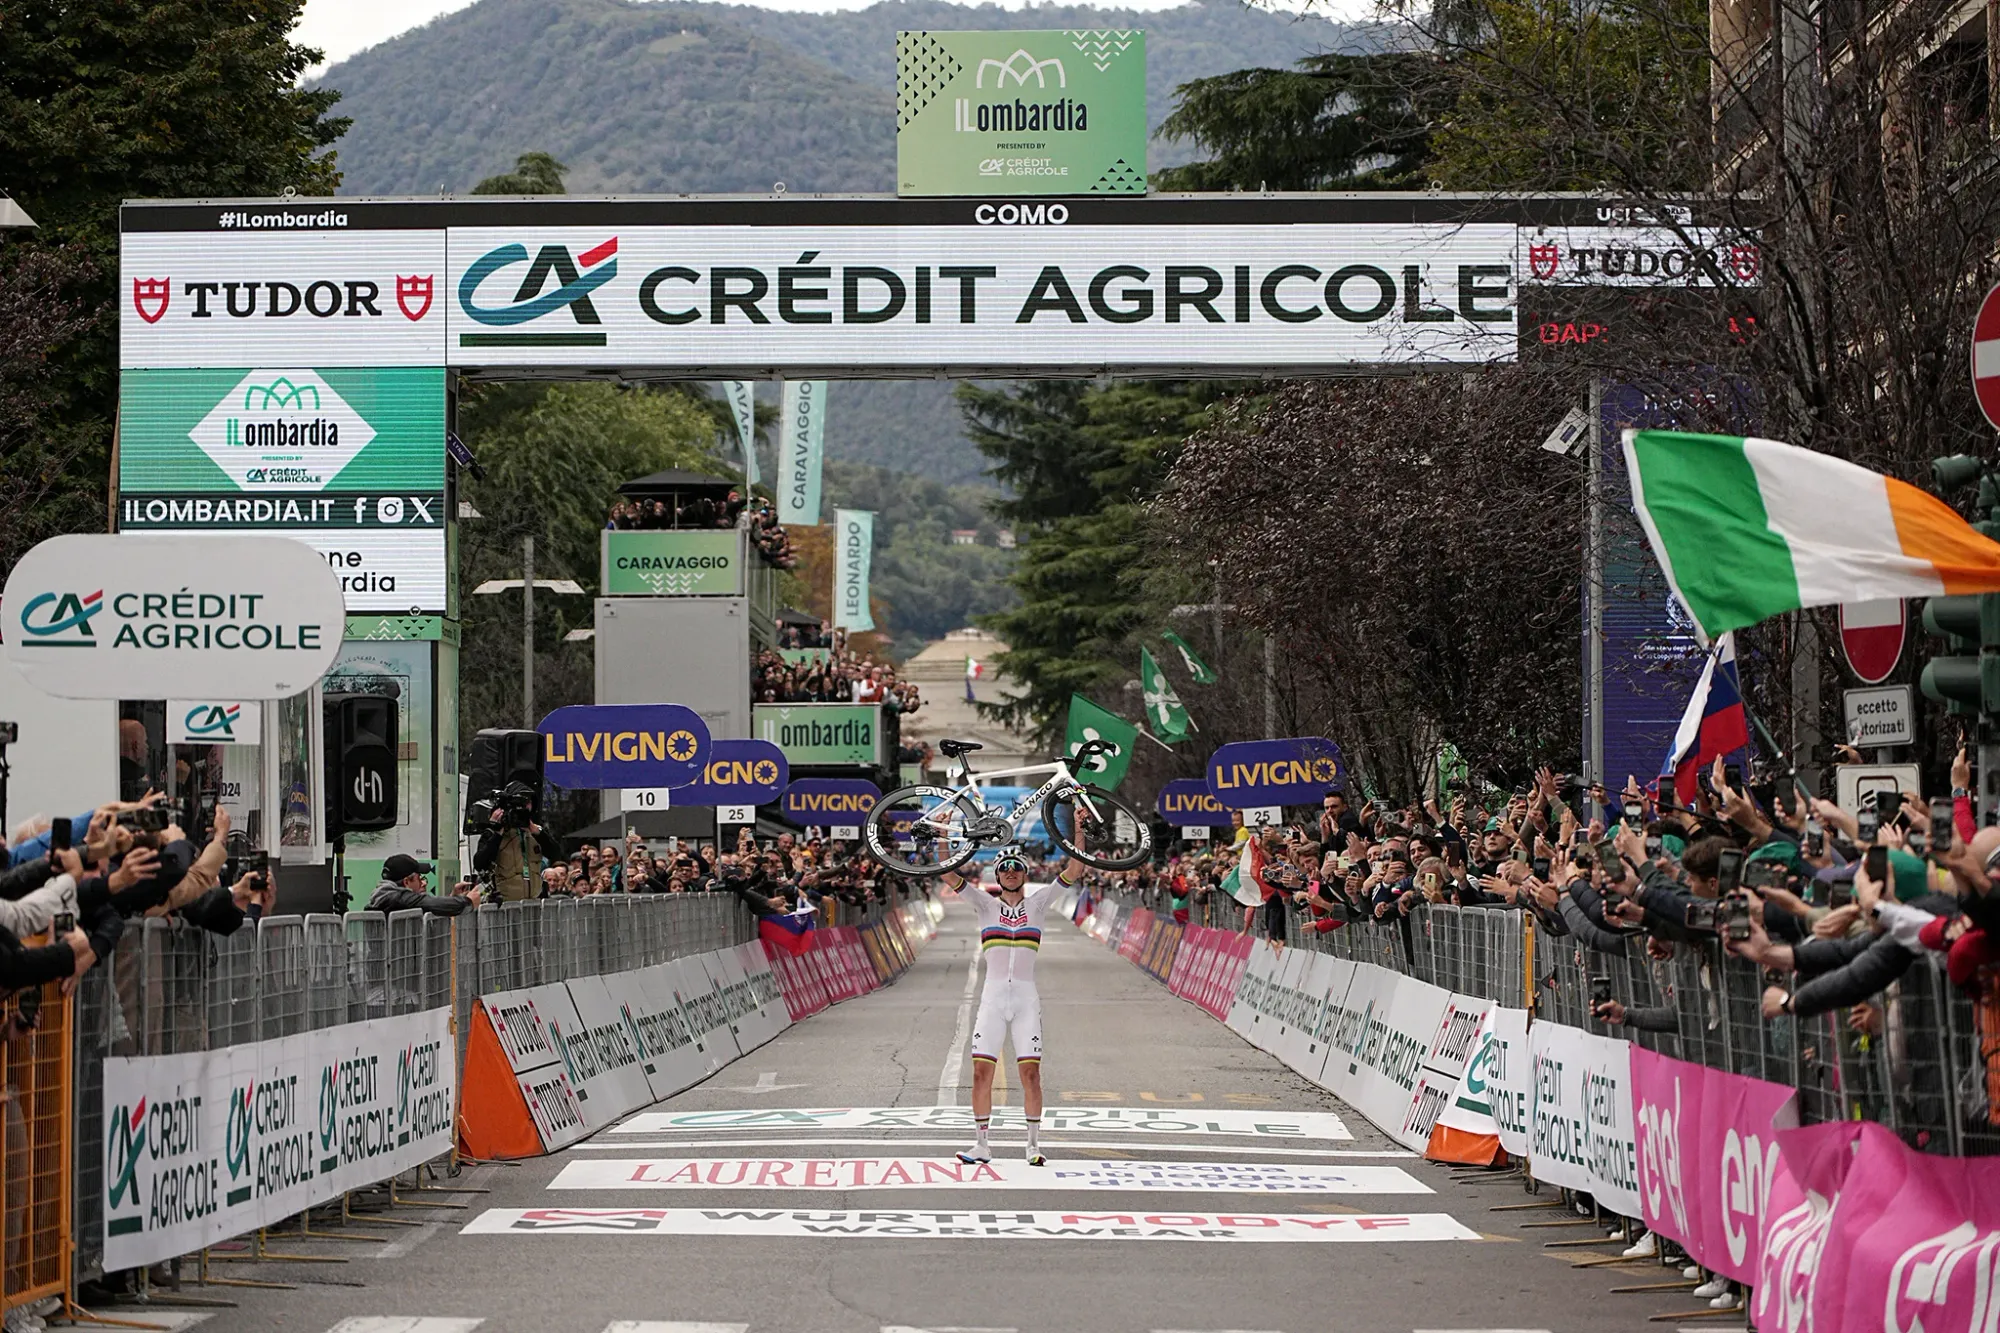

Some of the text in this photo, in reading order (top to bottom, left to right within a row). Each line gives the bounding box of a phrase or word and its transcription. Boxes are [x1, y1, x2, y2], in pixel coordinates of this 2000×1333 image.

[955, 97, 1087, 132] ILombardia
[1006, 157, 1051, 167] CRÉDIT
[1006, 167, 1068, 176] AGRICOLE
[219, 211, 348, 228] #ILombardia
[975, 204, 1069, 225] COMO
[185, 280, 382, 318] TUDOR
[638, 251, 1512, 325] CRÉDIT AGRICOLE
[227, 418, 338, 446] ILombardia
[791, 381, 813, 510] CARAVAGGIO
[269, 467, 308, 476] CRÉDIT
[269, 476, 322, 484] AGRICOLE
[125, 499, 335, 523] ILOMBARDIA.IT
[617, 556, 729, 570] CARAVAGGIO
[845, 521, 861, 617] LEONARDO
[113, 587, 264, 619] CRÉDIT
[112, 624, 321, 650] AGRICOLE
[1857, 699, 1897, 715] eccetto
[1861, 718, 1905, 736] torizzati
[546, 730, 698, 762] LIVIGNO
[694, 760, 779, 786] IGNO
[1216, 757, 1337, 789] LIVIGNO
[221, 783, 241, 797] 024
[636, 792, 656, 806] 10
[789, 793, 876, 812] LIVIGNO
[1012, 782, 1053, 820] COLNAGO
[1165, 794, 1233, 812] LIVIG
[729, 809, 744, 820] 25
[1254, 810, 1271, 823] 25
[839, 828, 851, 837] 50
[1191, 828, 1203, 837] 50
[1001, 905, 1027, 919] UAE
[501, 1005, 547, 1056] TUDOR
[1440, 1010, 1479, 1062] TUDOR
[412, 1033, 441, 1090] CRÉDIT
[1378, 1028, 1428, 1092] AGRICOLE
[339, 1047, 378, 1109] CRÉDIT
[256, 1067, 297, 1136] CRÉDIT
[412, 1087, 451, 1140] AGRICOLE
[533, 1079, 578, 1132] TUDOR
[149, 1085, 202, 1161] CRÉDIT
[339, 1106, 394, 1165] AGRICOLE
[256, 1131, 314, 1199] AGRICOLE
[1101, 1162, 1286, 1173] L'acqua
[1638, 1076, 1690, 1239] enel
[626, 1158, 1008, 1187] LAURETANA
[1089, 1179, 1327, 1190] d'Europa
[1151, 1171, 1347, 1182] leggera
[149, 1158, 218, 1232] AGRICOLE
[801, 1224, 1244, 1238] WORKWEAR
[1061, 1213, 1410, 1231] MODYF
